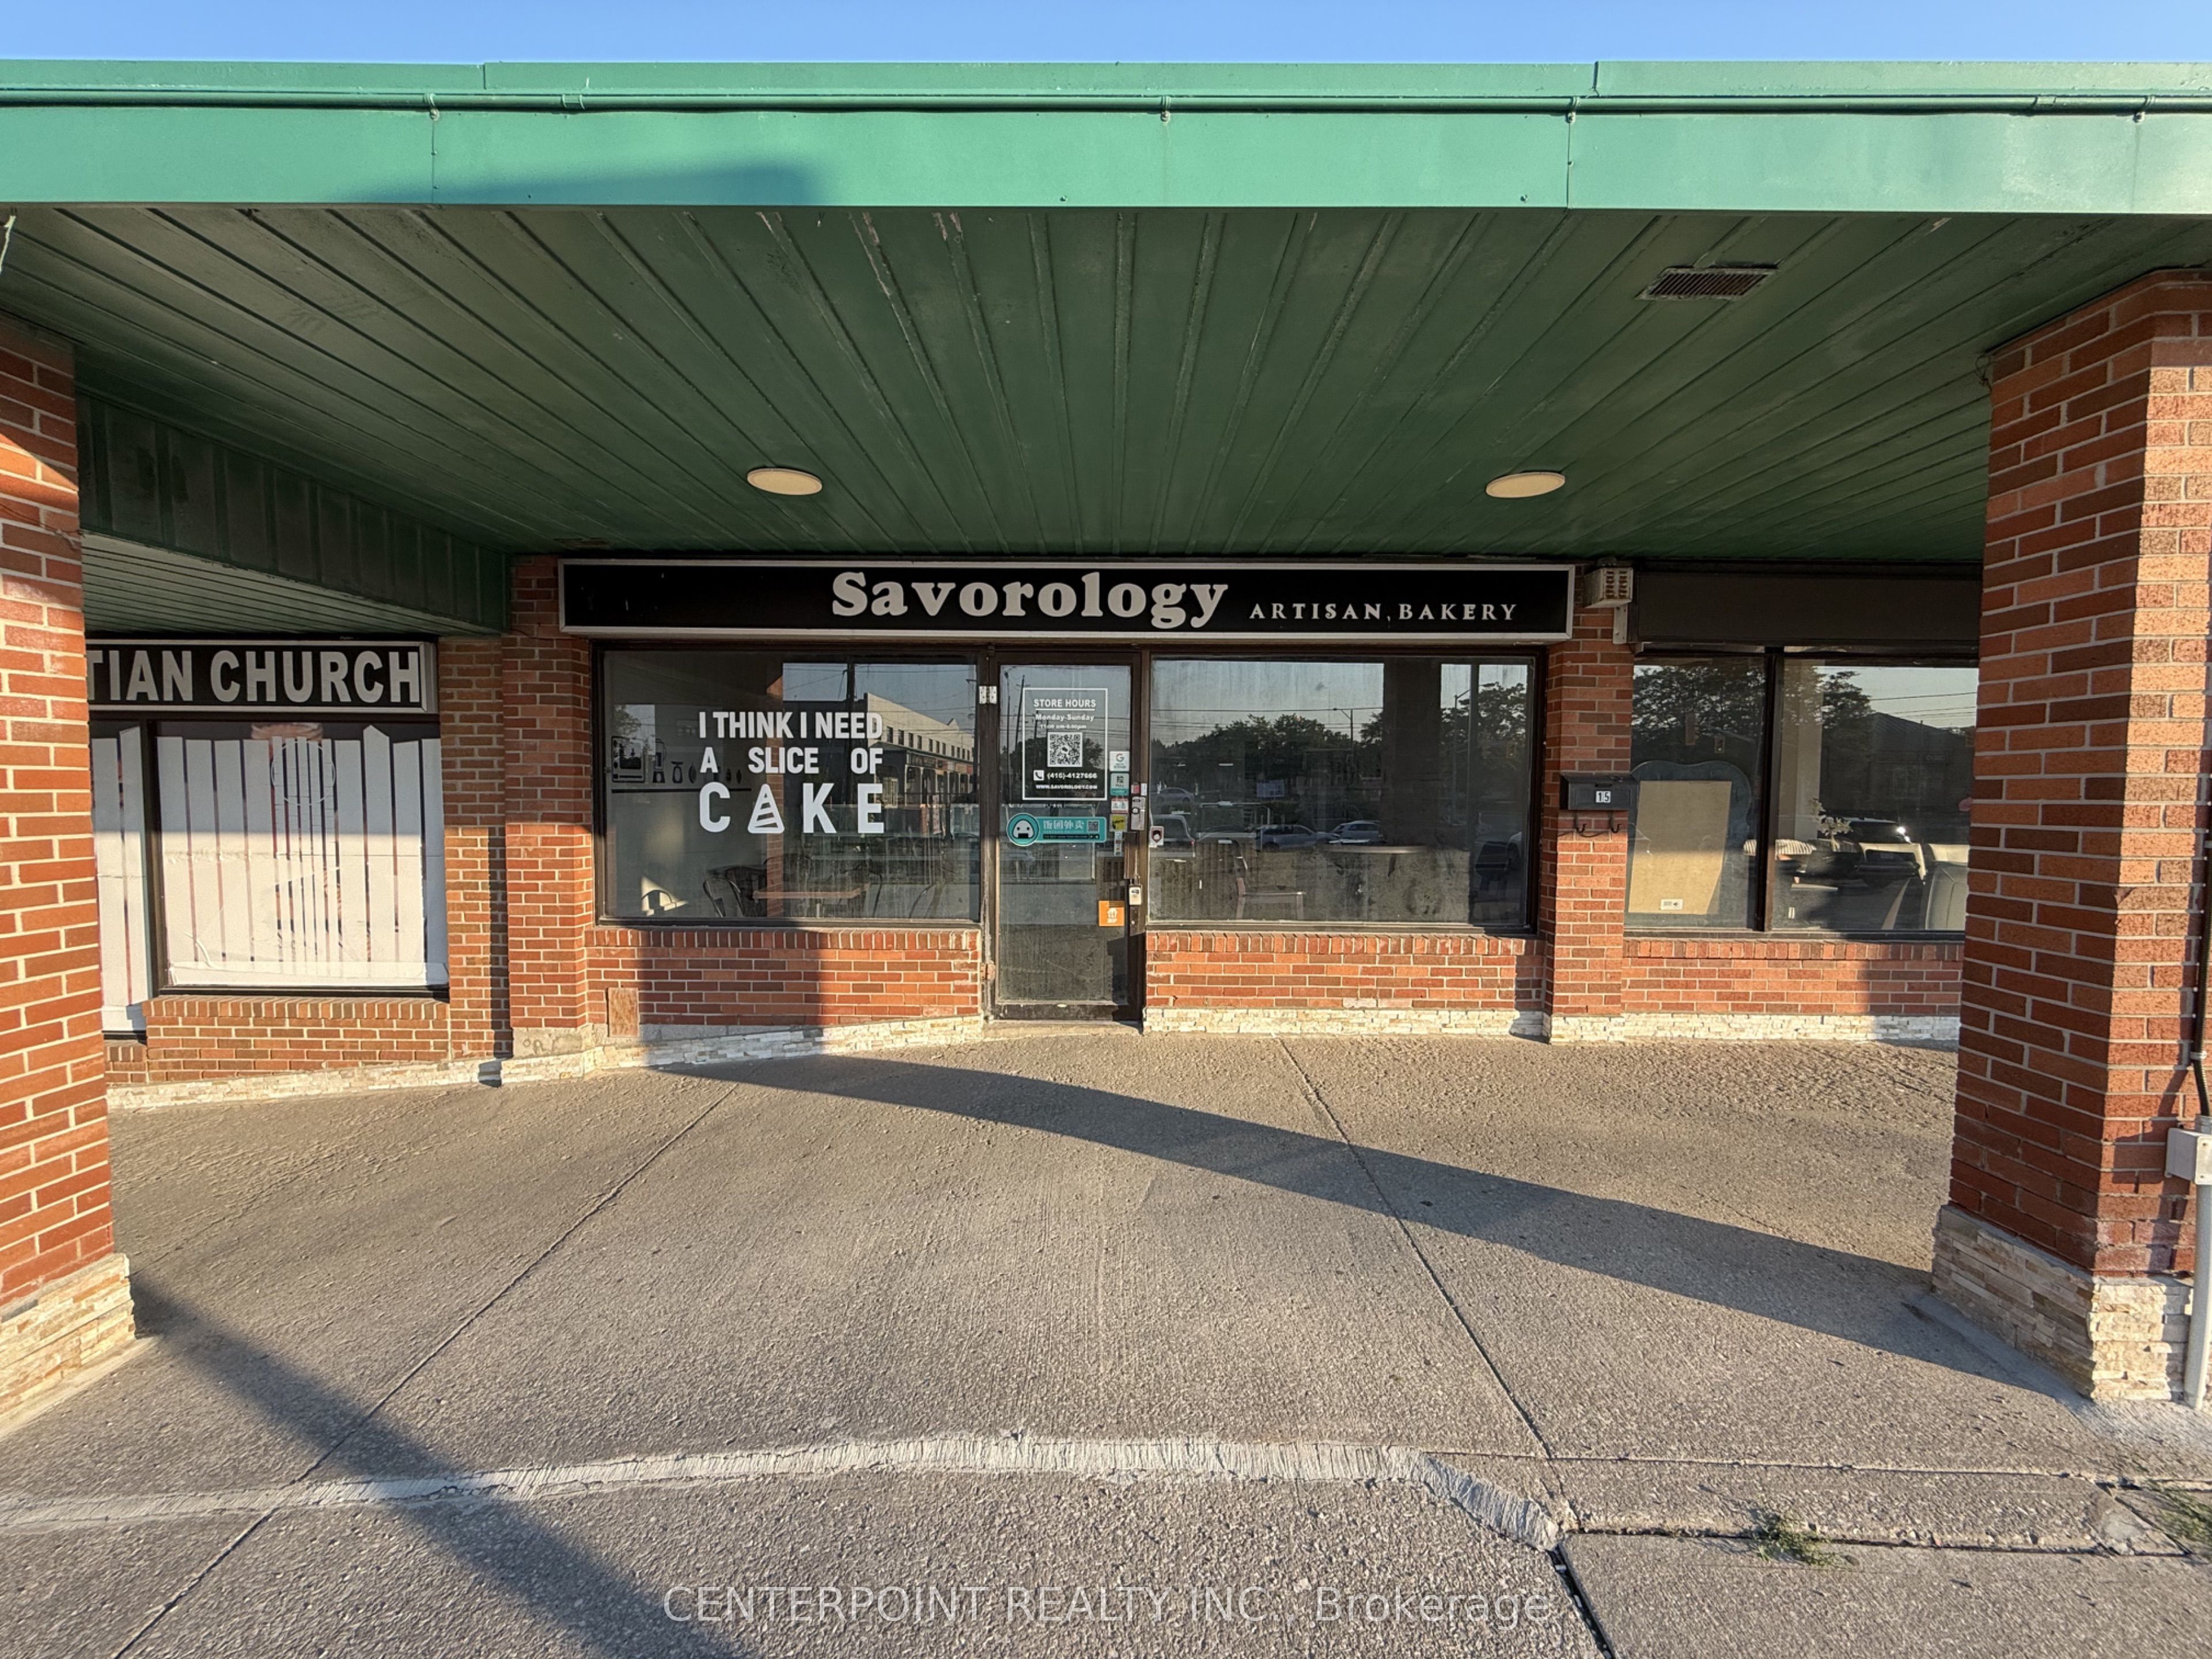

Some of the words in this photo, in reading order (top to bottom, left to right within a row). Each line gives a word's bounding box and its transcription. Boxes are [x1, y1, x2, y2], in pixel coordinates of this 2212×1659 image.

[832, 571, 1229, 628] Savorology
[1249, 603, 1381, 620] ARTISAN
[1398, 603, 1518, 622] BAKERY
[210, 650, 420, 703] CHURCH
[1033, 699, 1063, 707] STORE
[1065, 699, 1096, 707] HOURS
[699, 711, 706, 738] I
[713, 711, 794, 738] THINK
[800, 711, 807, 738] I
[815, 711, 883, 739] NEED
[1036, 714, 1094, 722] Monday-Sunday
[700, 747, 718, 773] A
[748, 747, 819, 774] SLICE
[850, 747, 883, 774] OF
[699, 782, 884, 834] CAKE
[1598, 792, 1609, 801] 15
